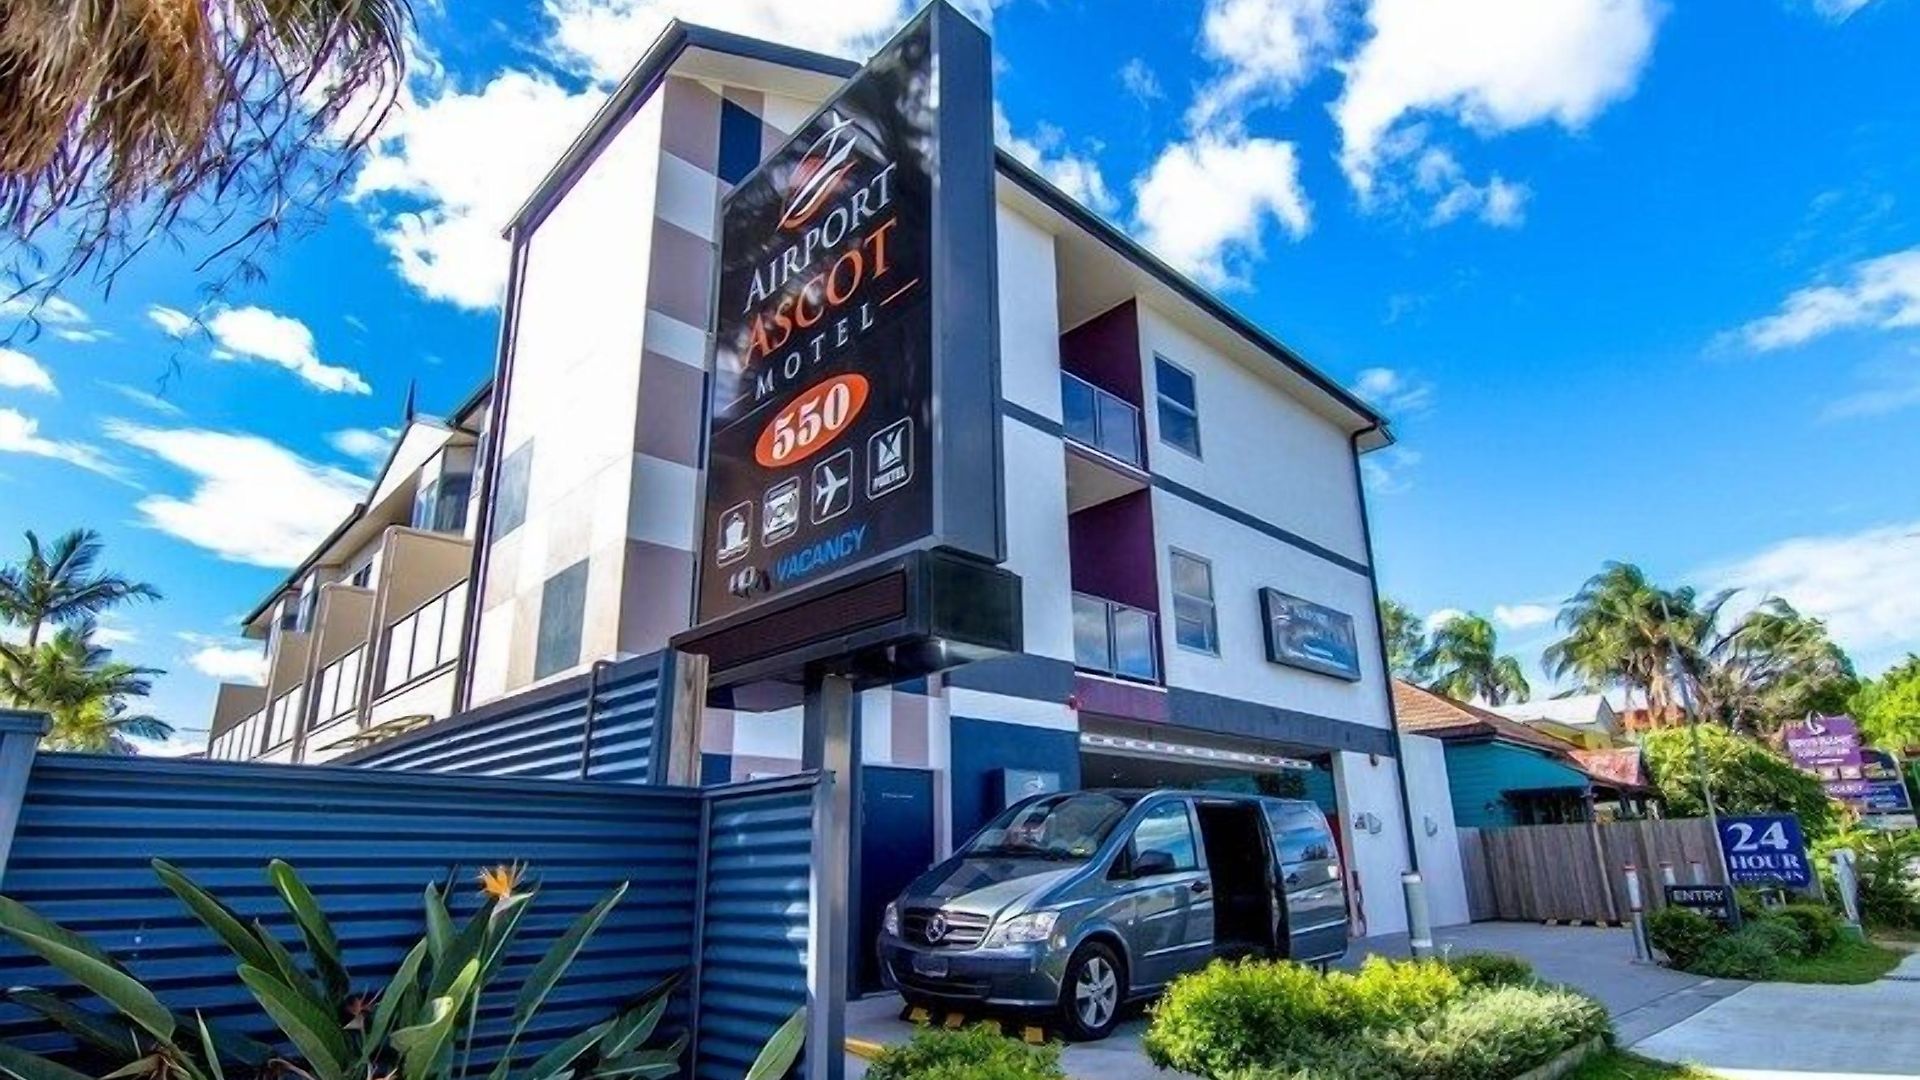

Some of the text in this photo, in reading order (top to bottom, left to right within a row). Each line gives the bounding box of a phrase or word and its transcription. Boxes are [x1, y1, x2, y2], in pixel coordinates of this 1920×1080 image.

[743, 162, 897, 313] AIRPORT
[743, 218, 897, 371] ASCOT
[755, 303, 874, 400] MOTEL
[772, 383, 850, 460] 550
[776, 524, 867, 580] VACANCY
[1727, 822, 1789, 851] 24
[1730, 854, 1801, 869] HOUR
[1673, 890, 1723, 901] ENTRY
